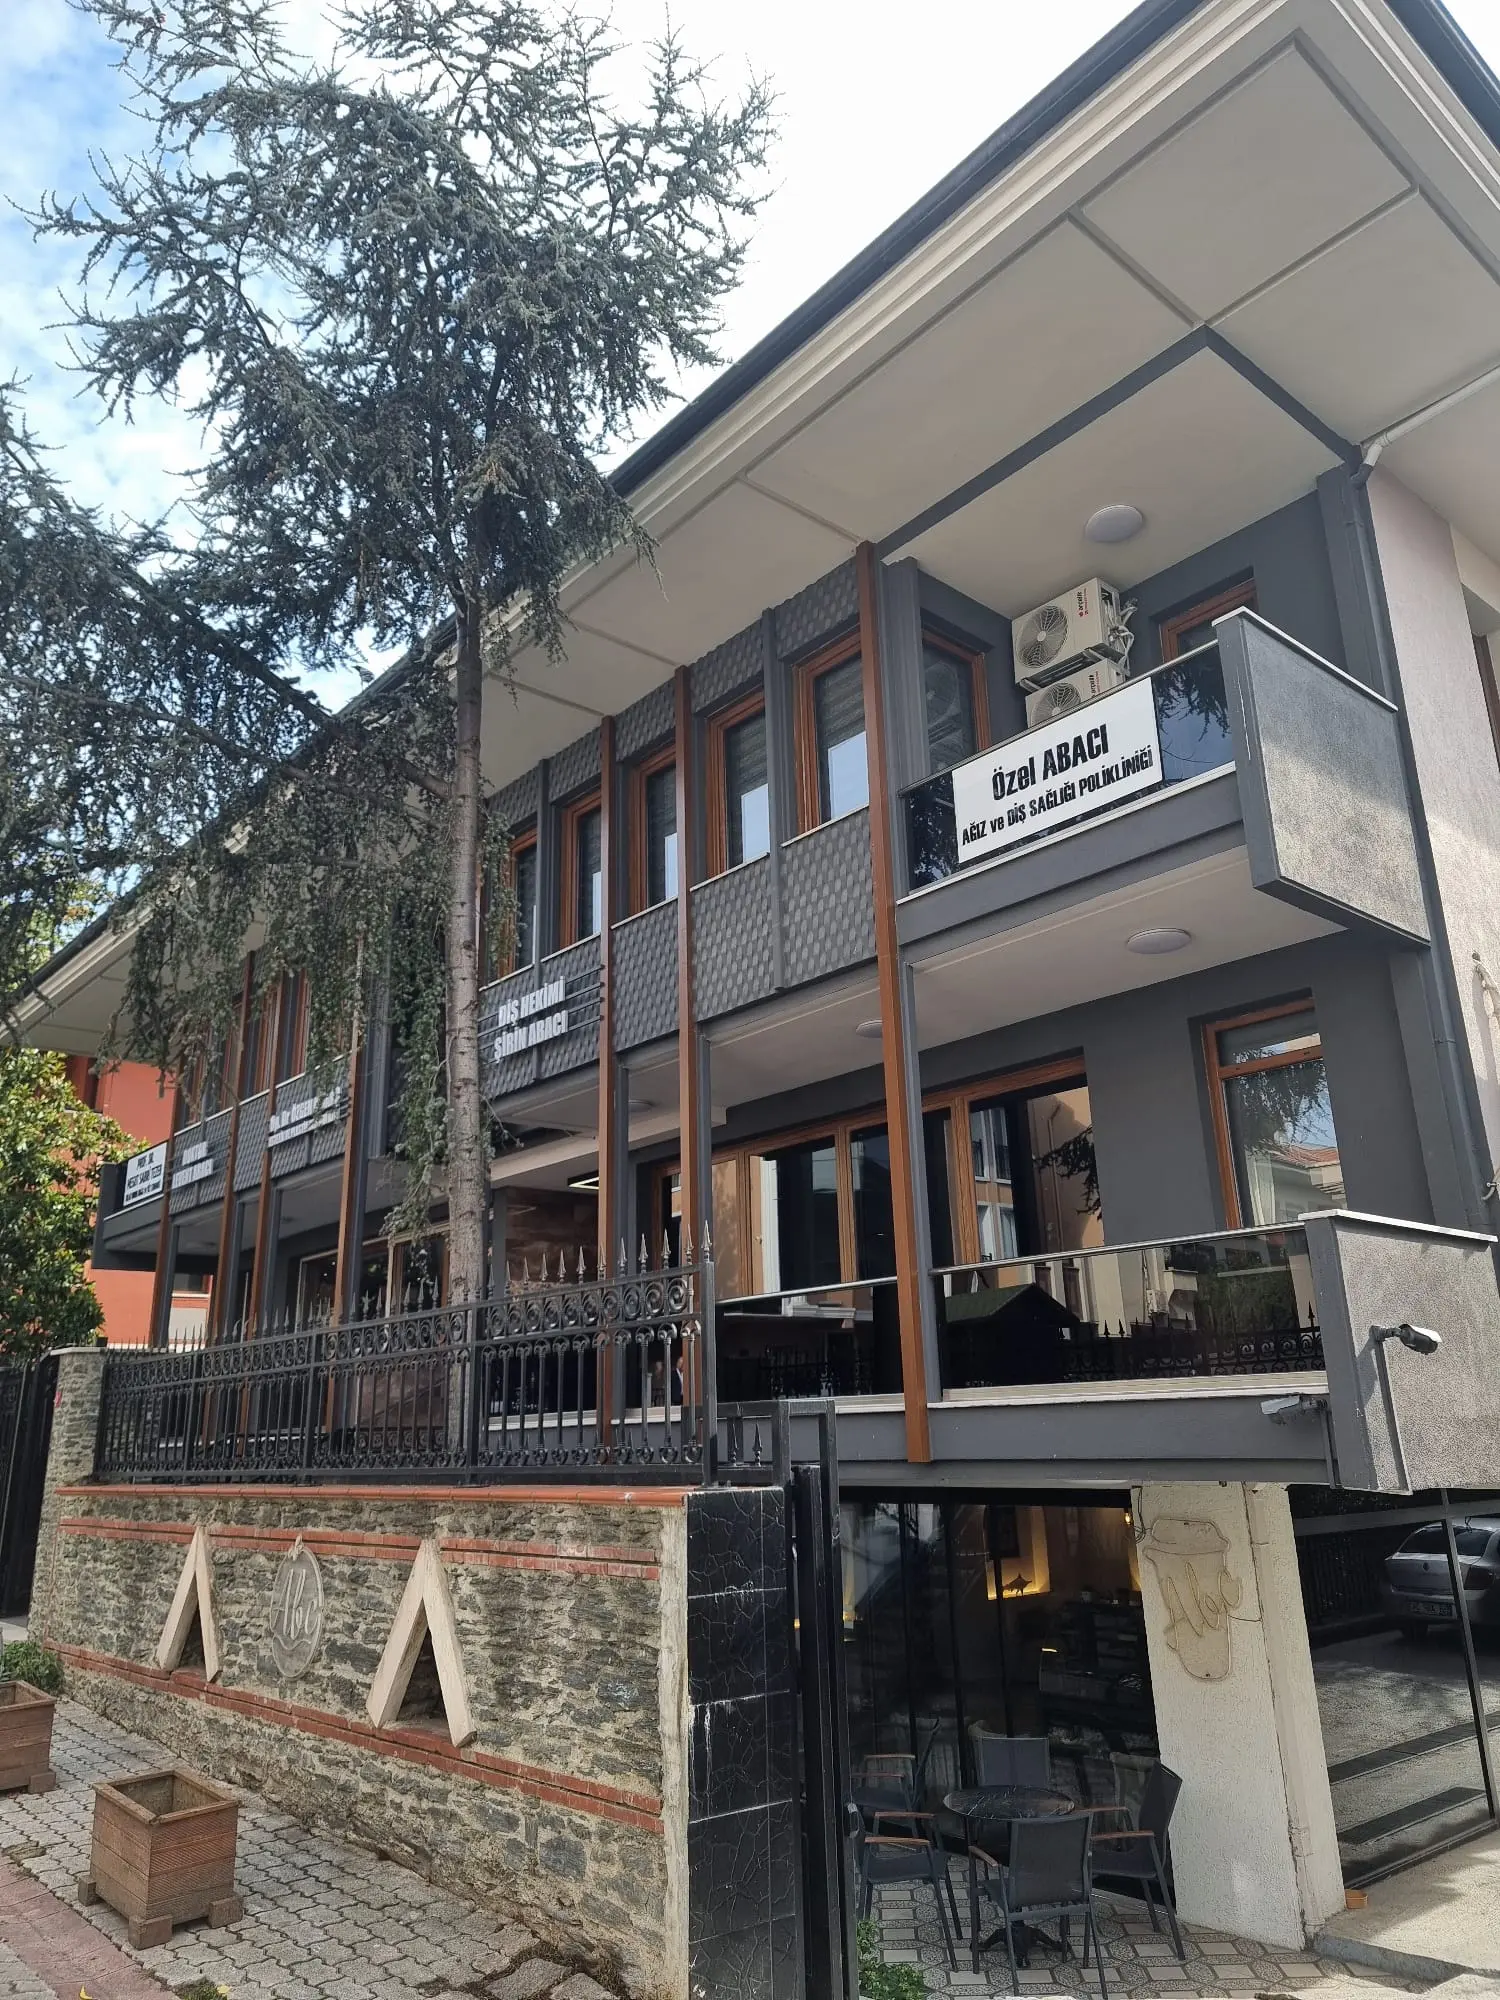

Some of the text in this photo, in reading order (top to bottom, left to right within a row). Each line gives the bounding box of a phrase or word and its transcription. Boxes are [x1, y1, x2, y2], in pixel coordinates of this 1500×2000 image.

[992, 724, 1109, 801] Özel ABACI
[962, 745, 1154, 846] AĞIZ ve DİŞ SAĞLIĞI POLİKLİNİĞİ
[498, 976, 566, 1027] DİŞ HEKİMİ
[494, 1010, 569, 1063] ŞİRİN ABACI
